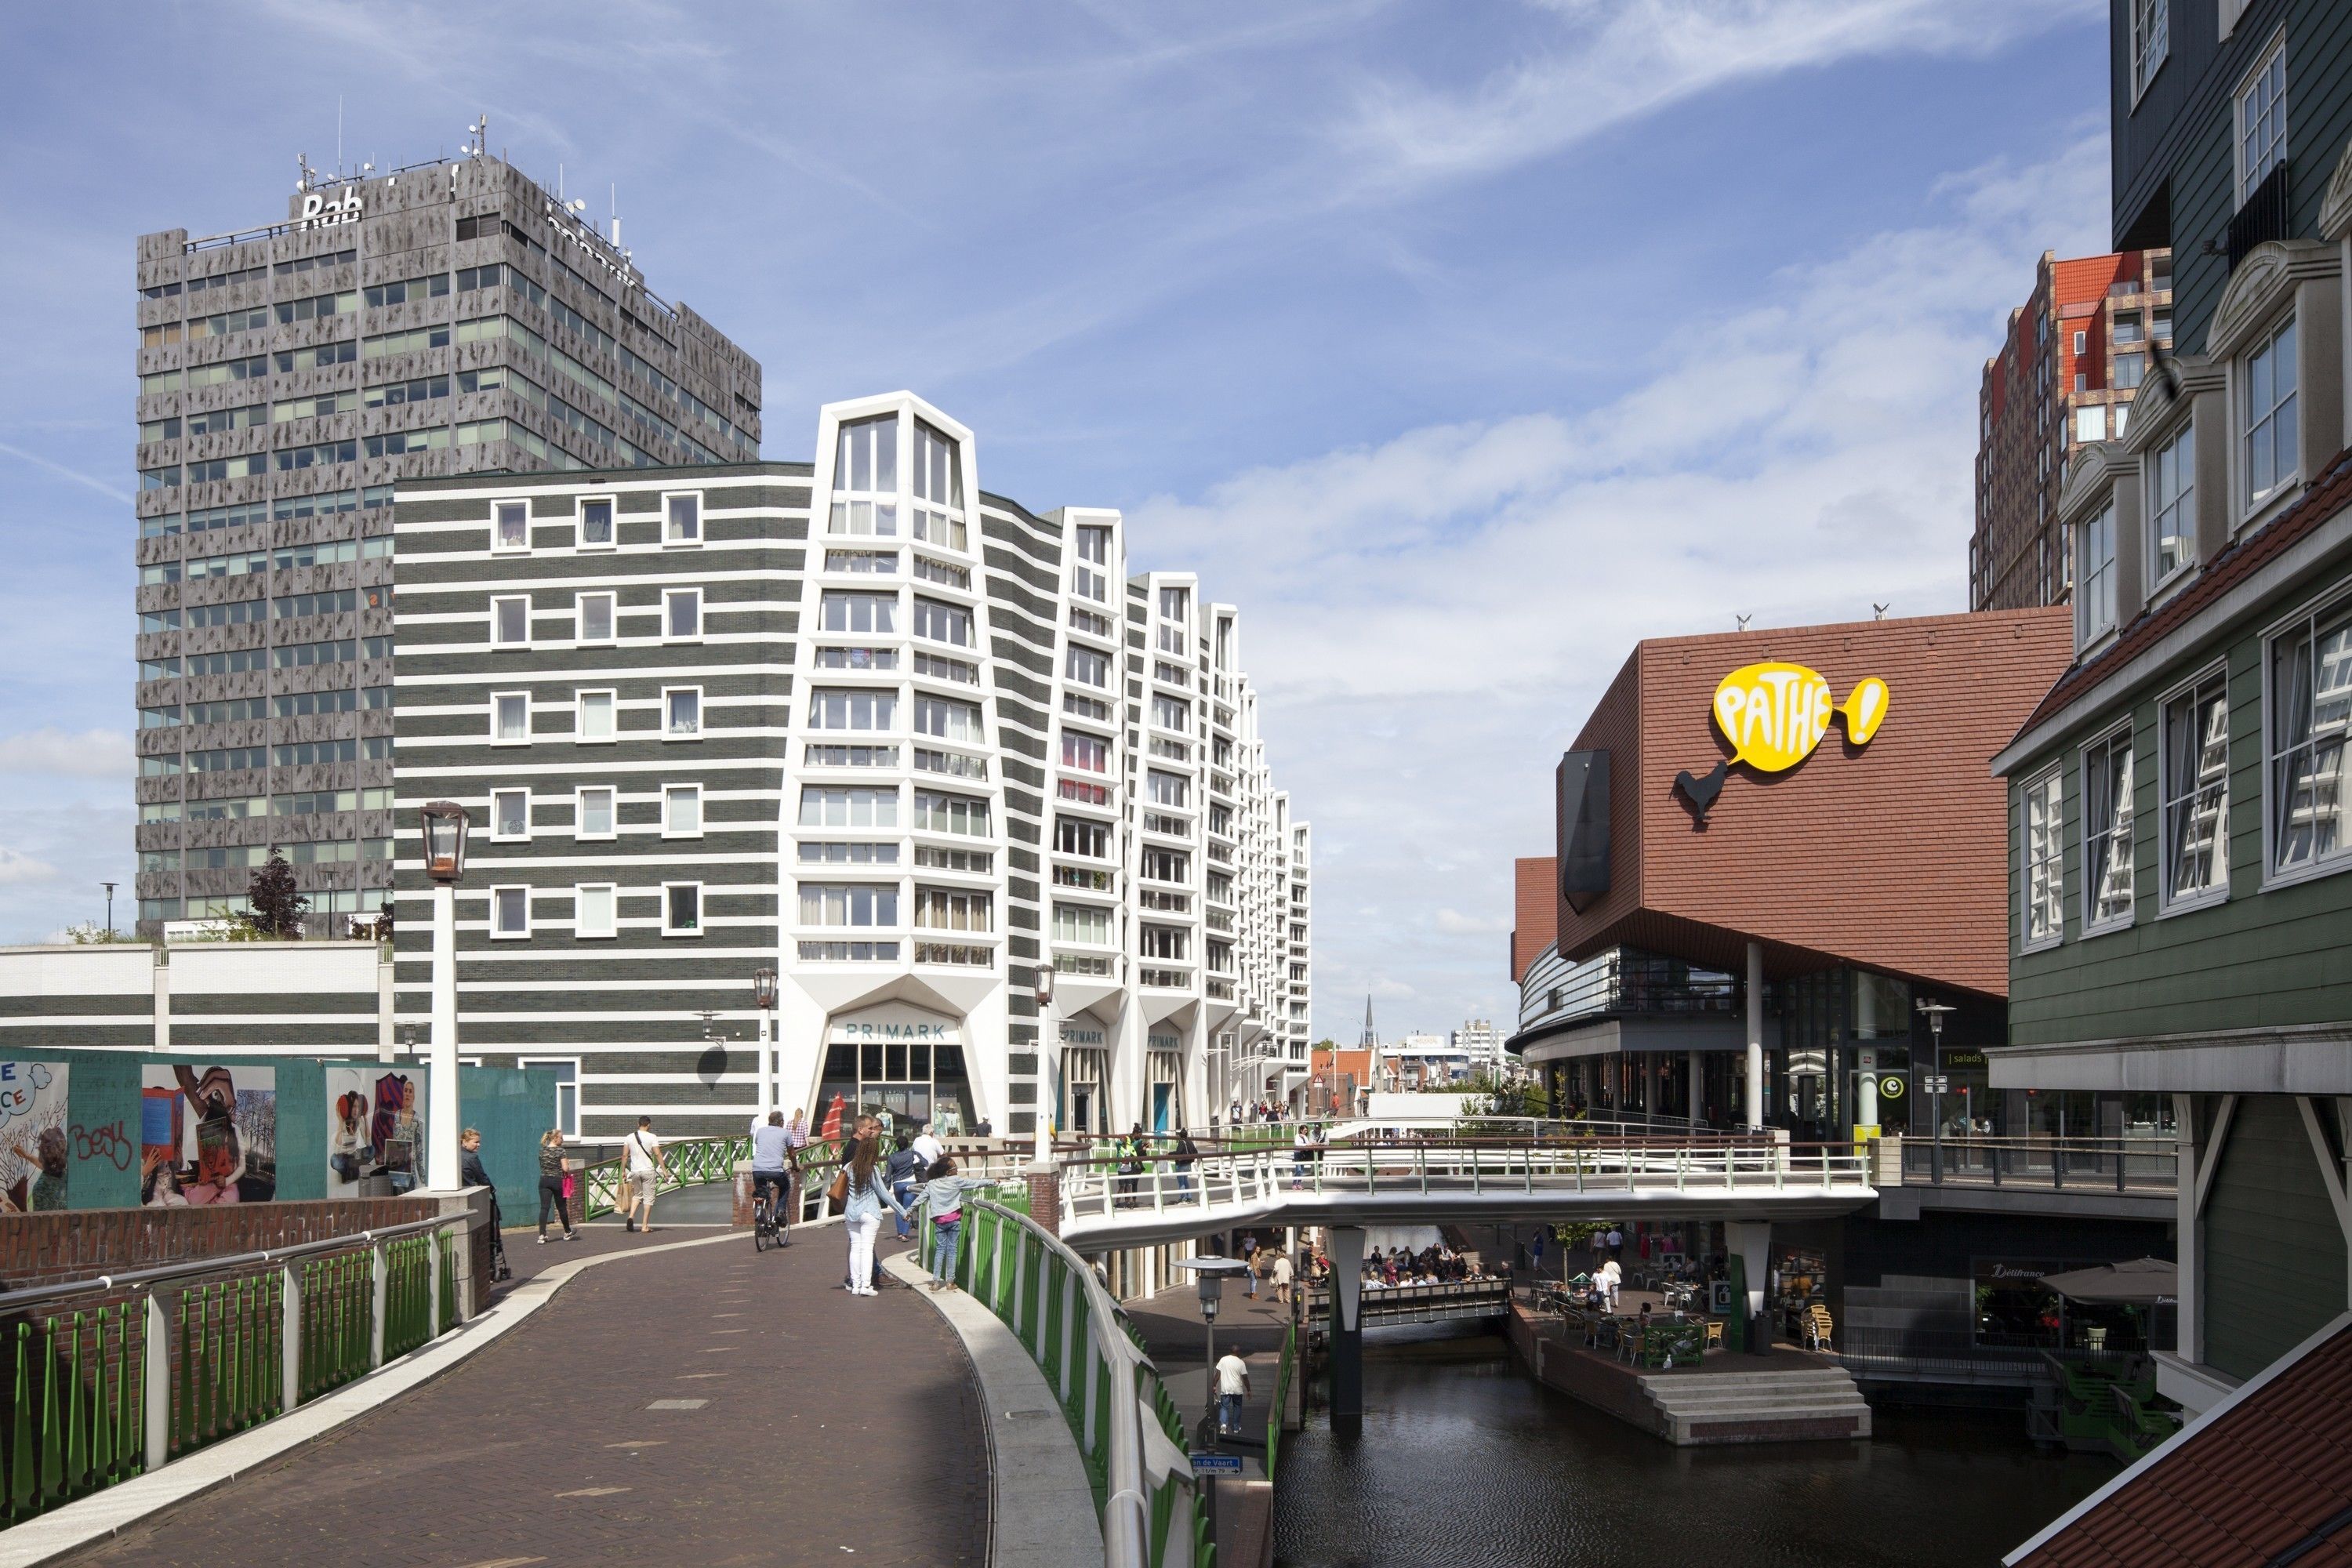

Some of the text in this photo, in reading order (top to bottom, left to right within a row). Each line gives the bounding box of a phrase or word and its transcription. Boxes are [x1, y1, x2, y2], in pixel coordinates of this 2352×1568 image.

[847, 1023, 945, 1040] PRIMARK
[1148, 1035, 1178, 1048] PRIMARK
[1954, 1054, 1982, 1062] salads
